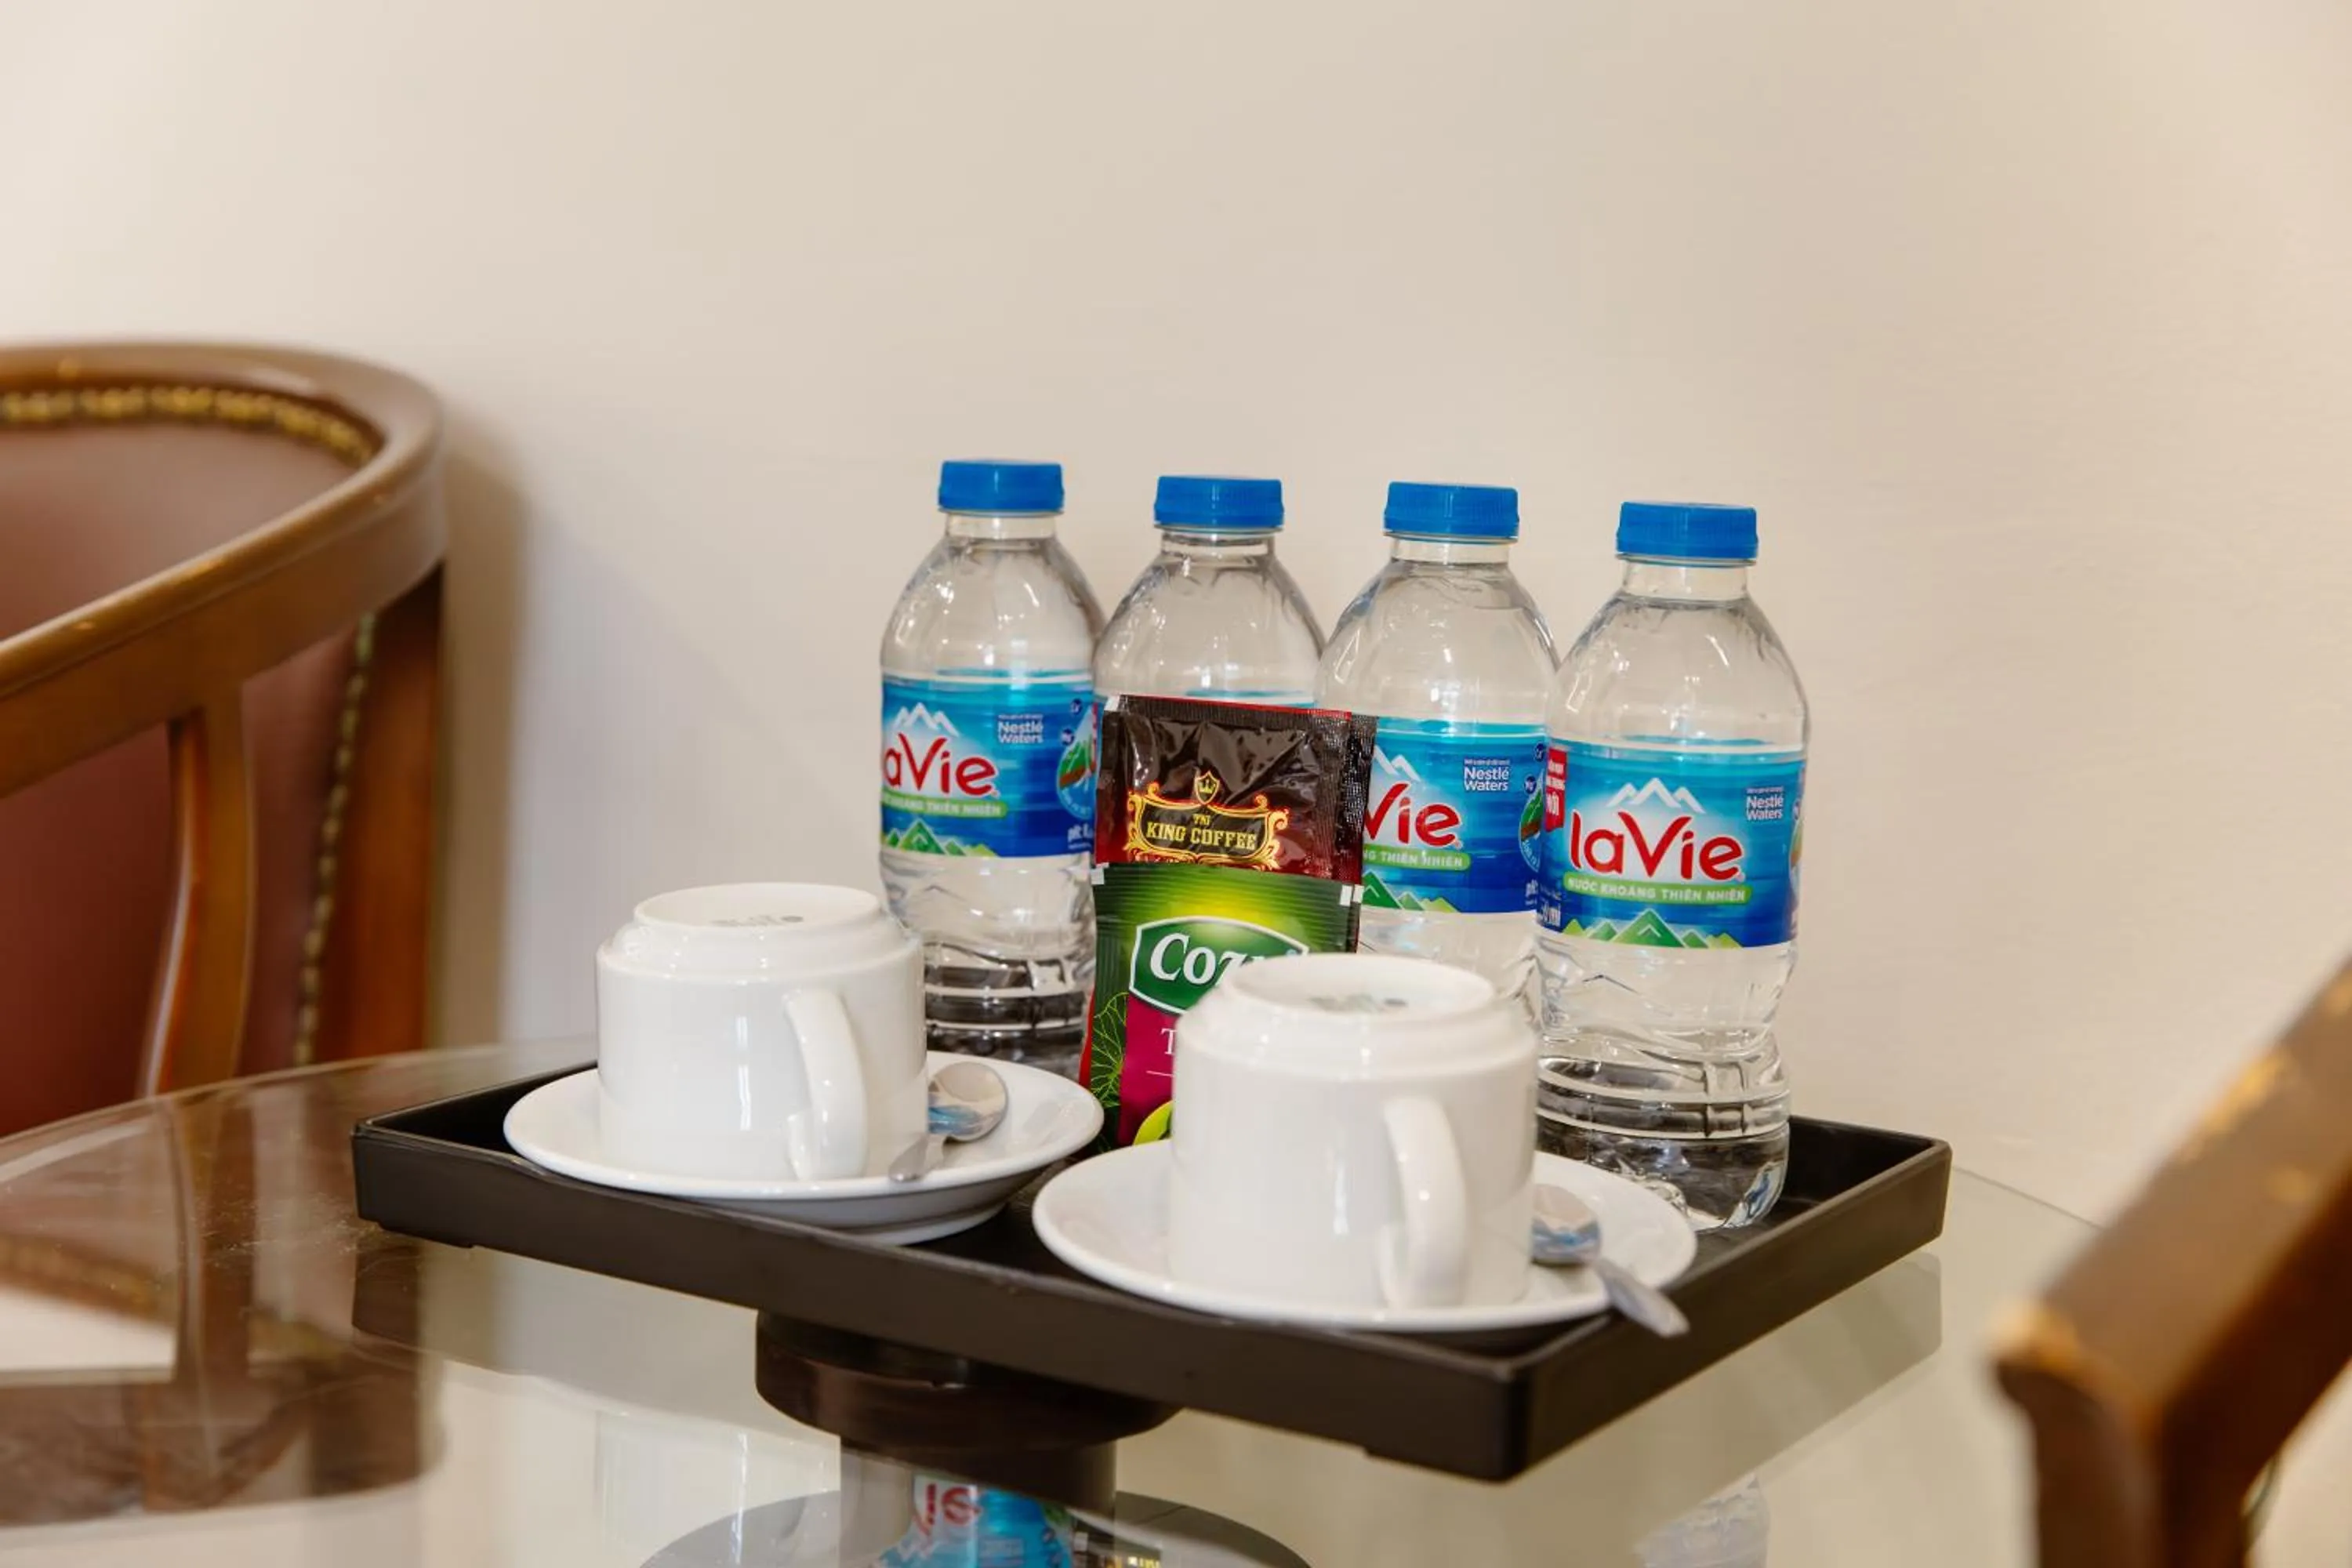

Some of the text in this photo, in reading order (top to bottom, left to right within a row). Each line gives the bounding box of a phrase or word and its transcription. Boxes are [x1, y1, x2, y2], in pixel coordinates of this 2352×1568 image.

[1465, 766, 1510, 780] Nestlé
[1465, 780, 1509, 791] Waters
[1146, 821, 1257, 851] KING COFFEE
[1570, 808, 1744, 881] laVie
[1149, 931, 1265, 986] Coz
